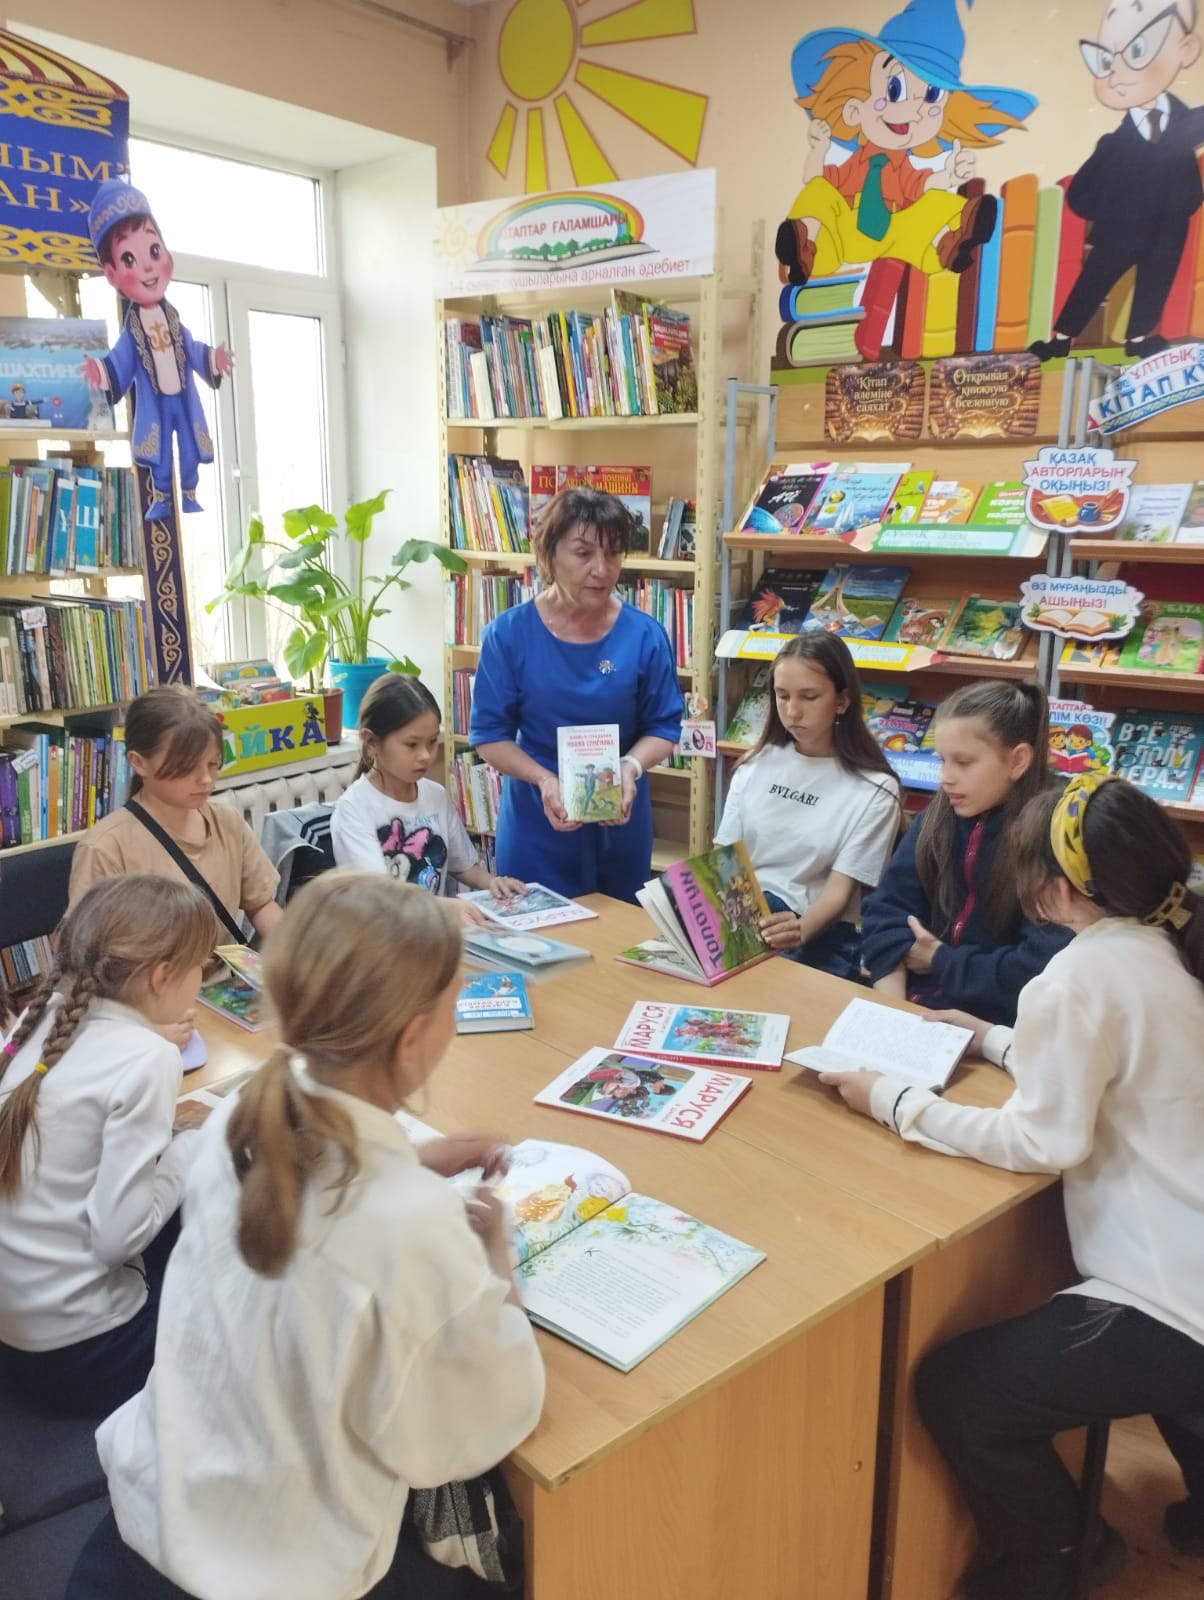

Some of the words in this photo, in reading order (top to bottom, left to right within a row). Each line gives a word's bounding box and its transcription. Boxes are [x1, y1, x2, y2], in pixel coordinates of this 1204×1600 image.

[953, 368, 1009, 386] Открывая
[1098, 375, 1173, 418] КІТАП
[1050, 453, 1096, 467] ҚАЗАҚ
[1031, 467, 1125, 478] АВТОРЛАРЫН
[1040, 480, 1111, 493] ОҚЫҢЫЗ!
[1031, 582, 1047, 591] ӨЗ
[1049, 582, 1127, 597] МҰРАҢЫЗДЫ
[1039, 596, 1107, 609] АШЫҢЫЗ!
[1049, 711, 1071, 721] ЛІМ
[769, 784, 820, 807] BVLGARI
[630, 1005, 666, 1050] МАРУСЯ
[670, 1073, 734, 1129] МАРУСЯ
